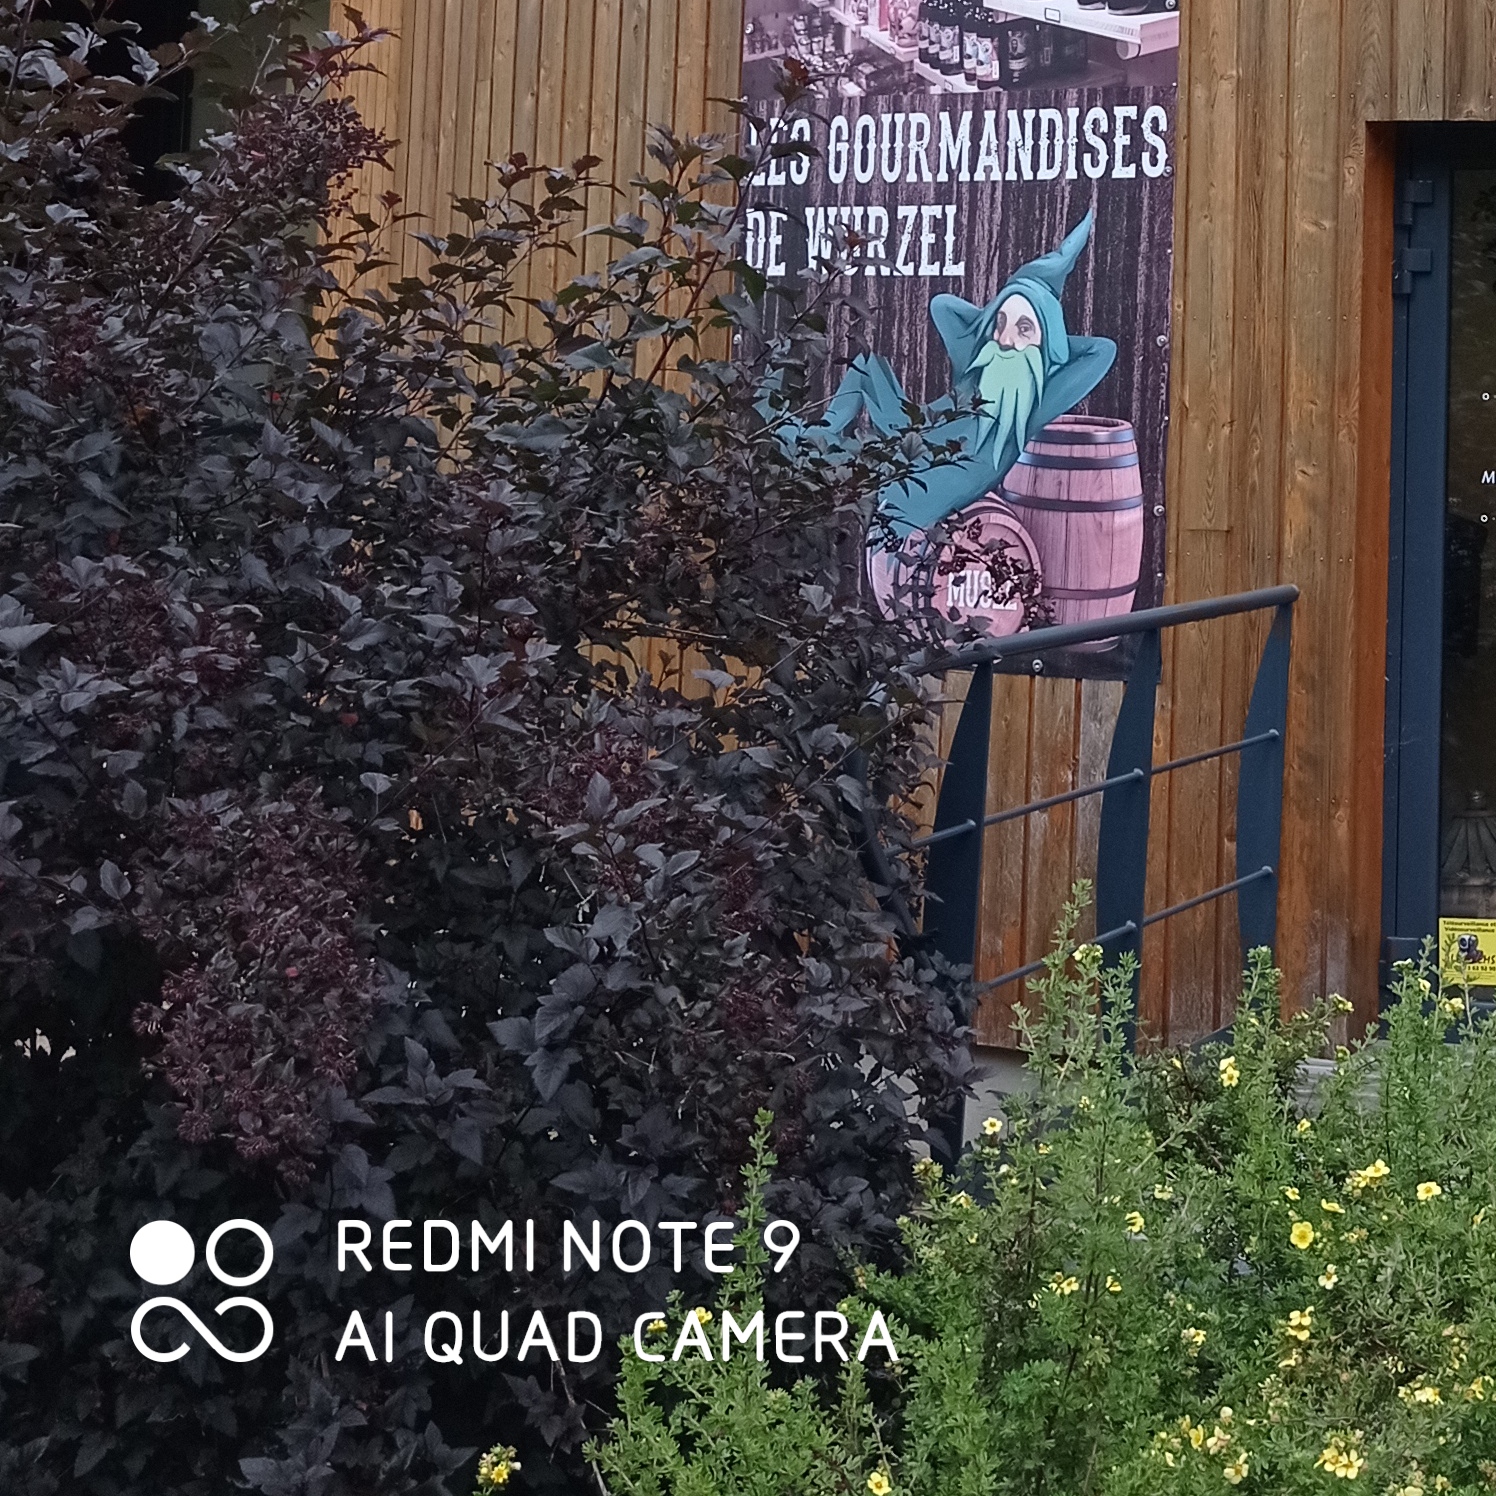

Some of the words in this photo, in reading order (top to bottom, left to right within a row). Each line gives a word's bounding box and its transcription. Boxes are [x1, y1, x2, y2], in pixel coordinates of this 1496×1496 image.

[828, 105, 1169, 184] GOURMANDISES
[745, 207, 788, 276] DE
[946, 569, 1017, 610] MUS
